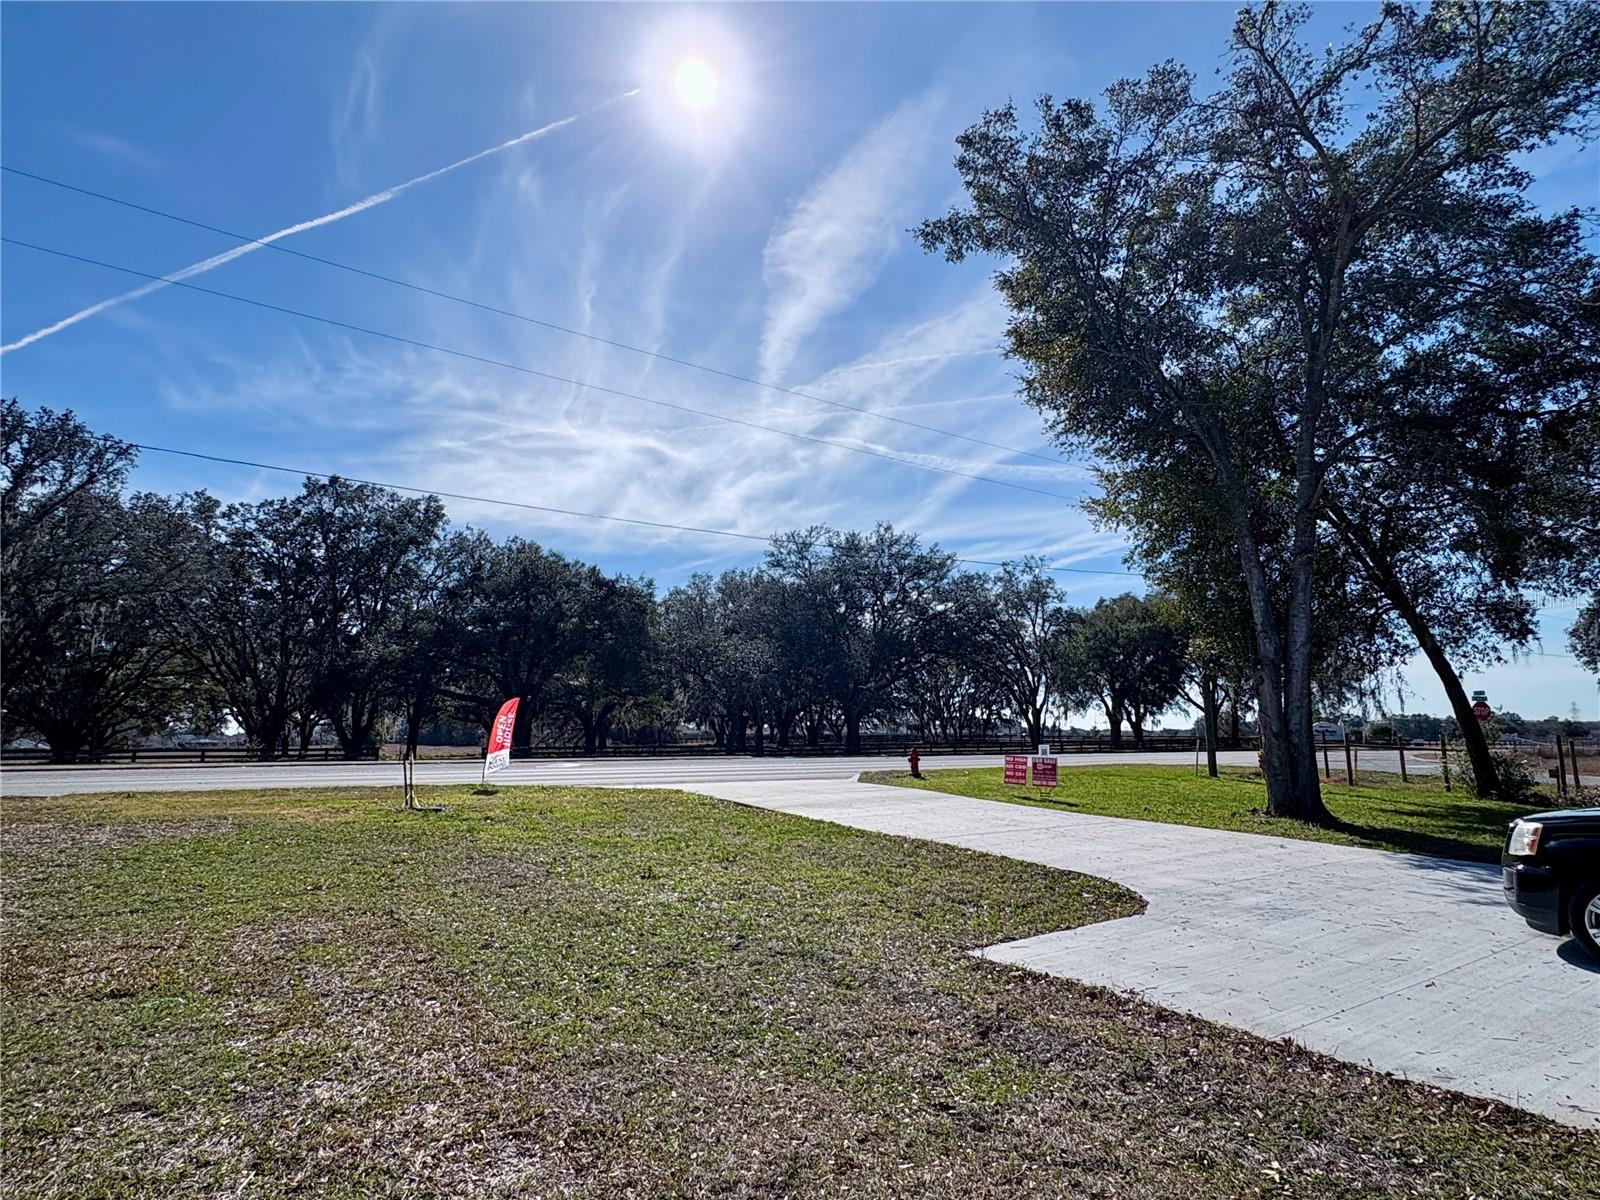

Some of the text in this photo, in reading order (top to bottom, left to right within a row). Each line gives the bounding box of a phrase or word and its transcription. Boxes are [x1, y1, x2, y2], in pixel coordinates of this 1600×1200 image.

[1474, 707, 1490, 715] STOP
[496, 716, 506, 743] OPEN
[503, 713, 515, 746] HOUSE
